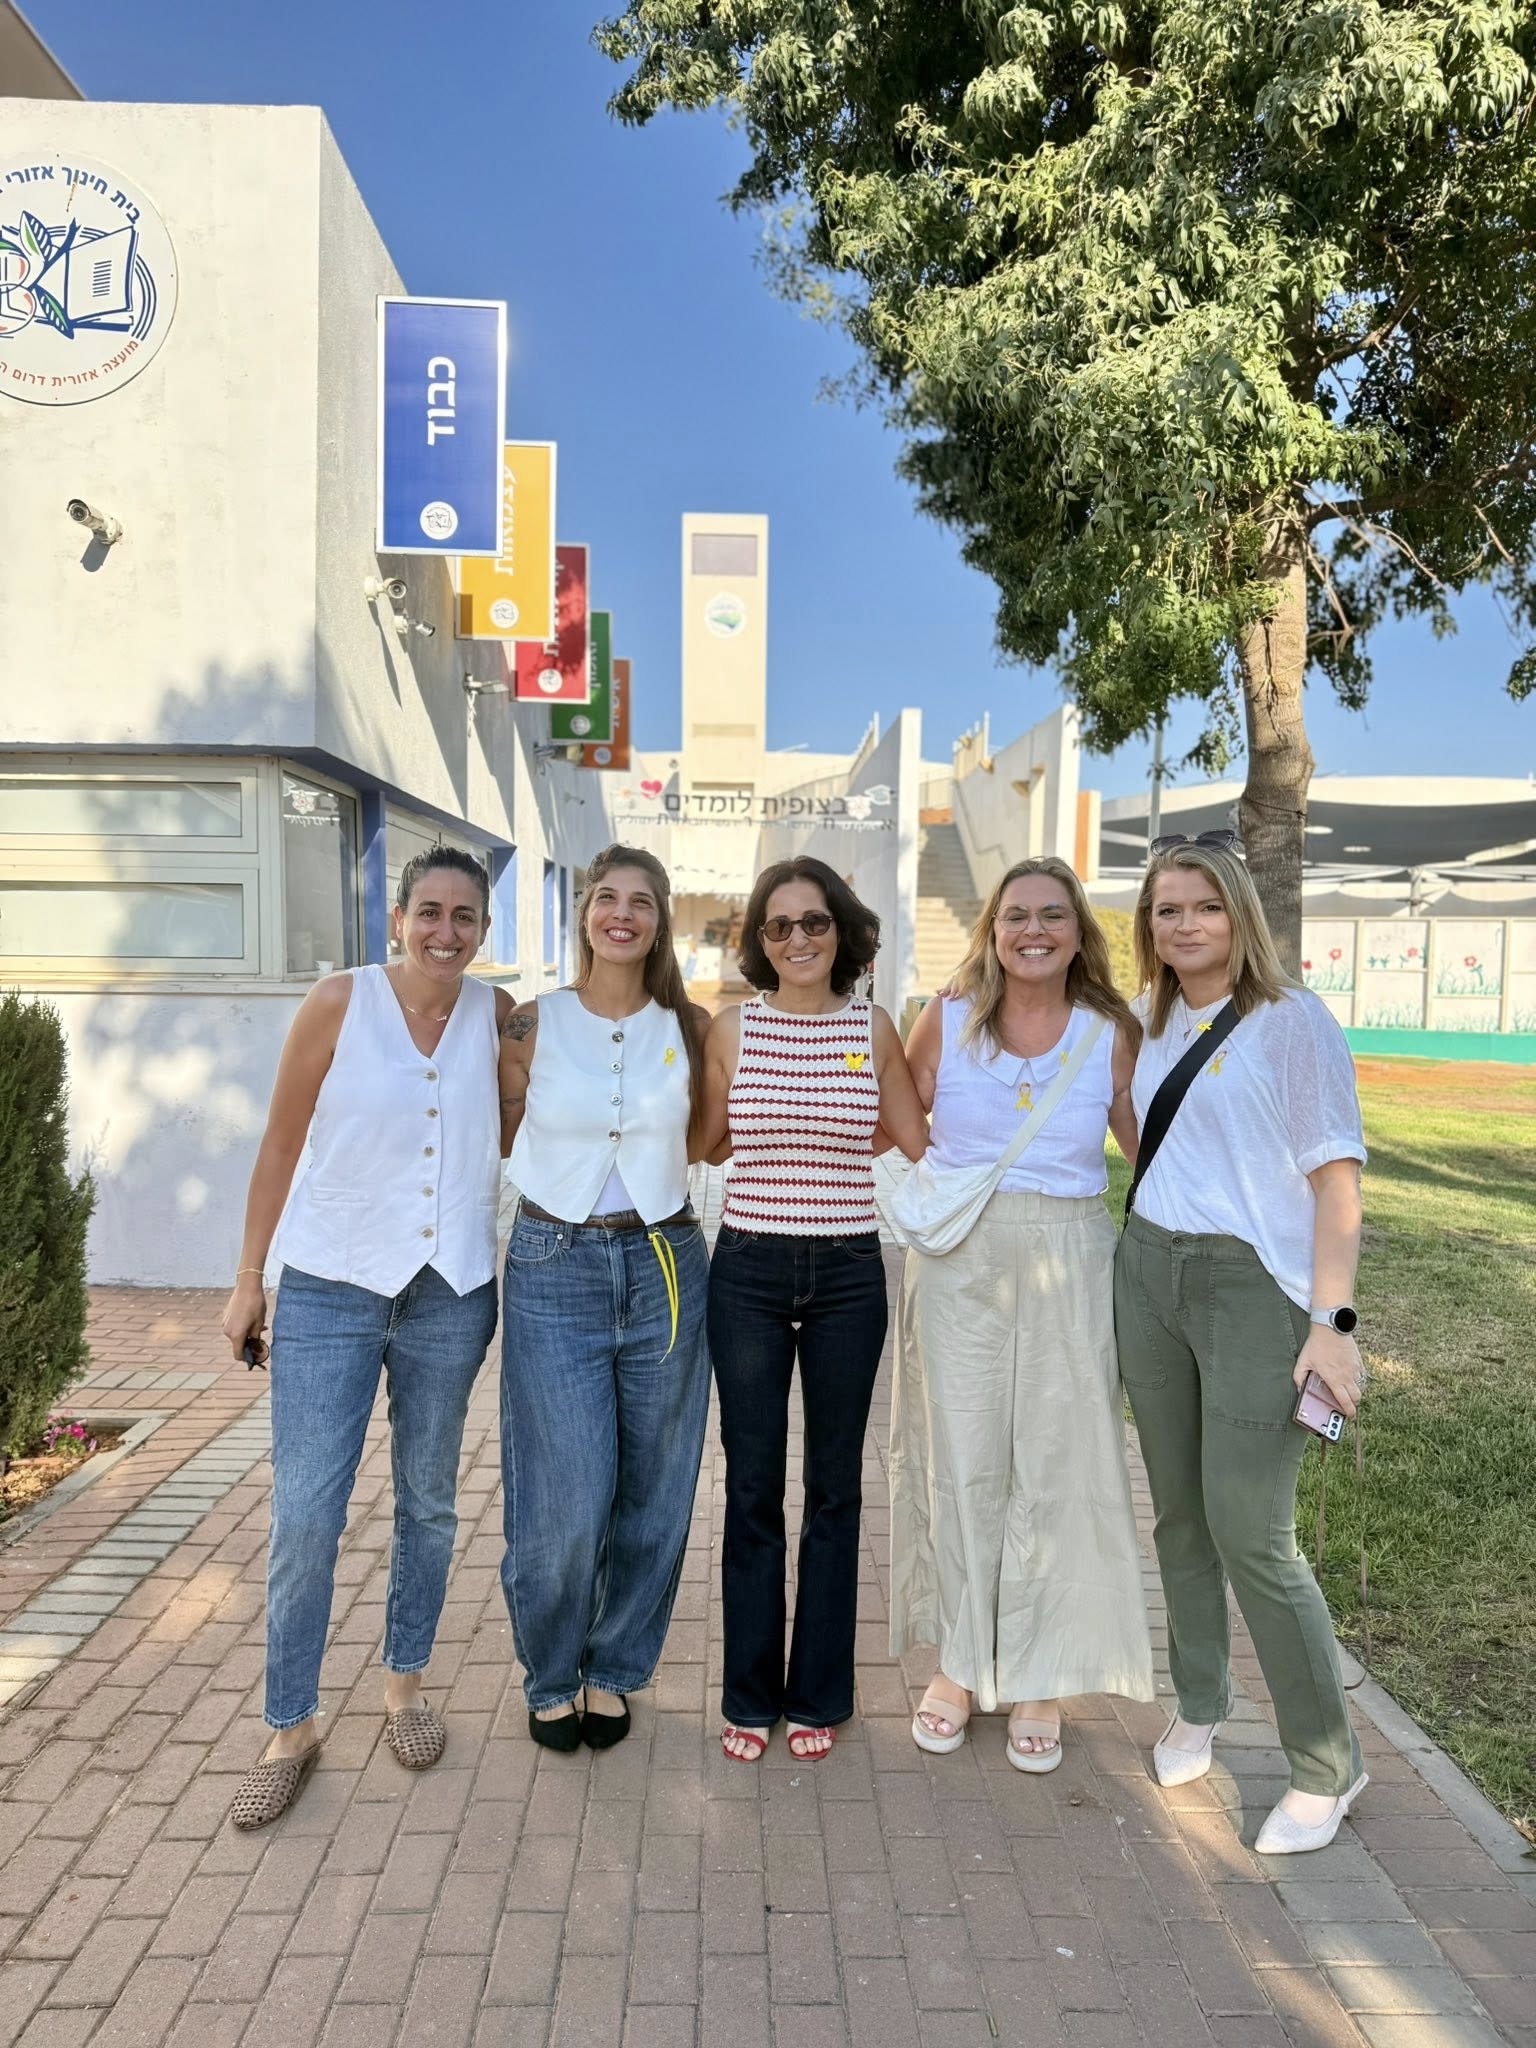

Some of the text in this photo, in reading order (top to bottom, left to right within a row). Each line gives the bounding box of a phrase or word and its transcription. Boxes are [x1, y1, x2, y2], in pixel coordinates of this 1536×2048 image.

[5, 165, 141, 225] בית חינוך אזורי
[12, 340, 139, 387] מועצה אזורית דרום
[427, 356, 456, 446] כבוד
[665, 790, 849, 815] בצופית לומדים
